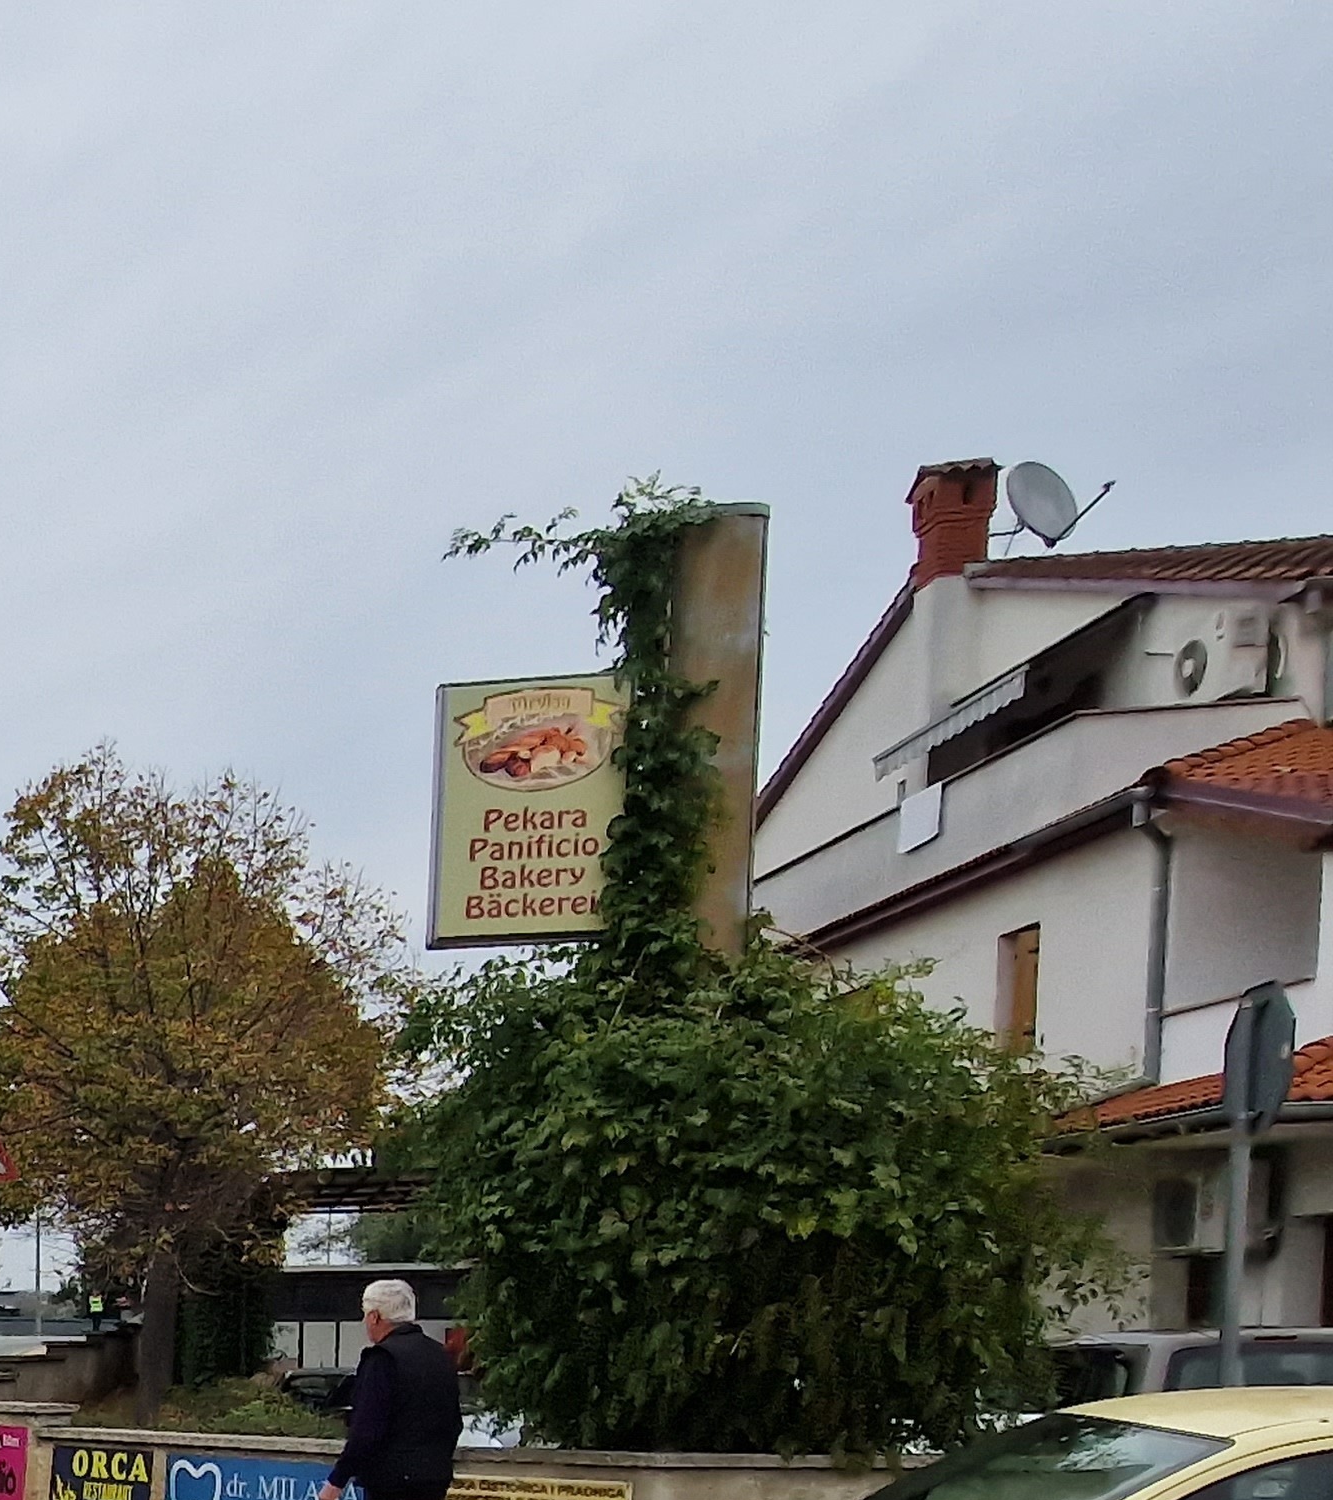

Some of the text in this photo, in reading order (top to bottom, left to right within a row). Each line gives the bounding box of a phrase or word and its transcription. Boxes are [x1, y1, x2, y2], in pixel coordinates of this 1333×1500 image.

[483, 806, 588, 833] Pekara
[469, 832, 600, 862] Panificio
[480, 863, 587, 890] Bakery
[465, 890, 600, 919] Bäckerei
[71, 1449, 148, 1483] ORCA
[225, 1472, 251, 1499] dr.
